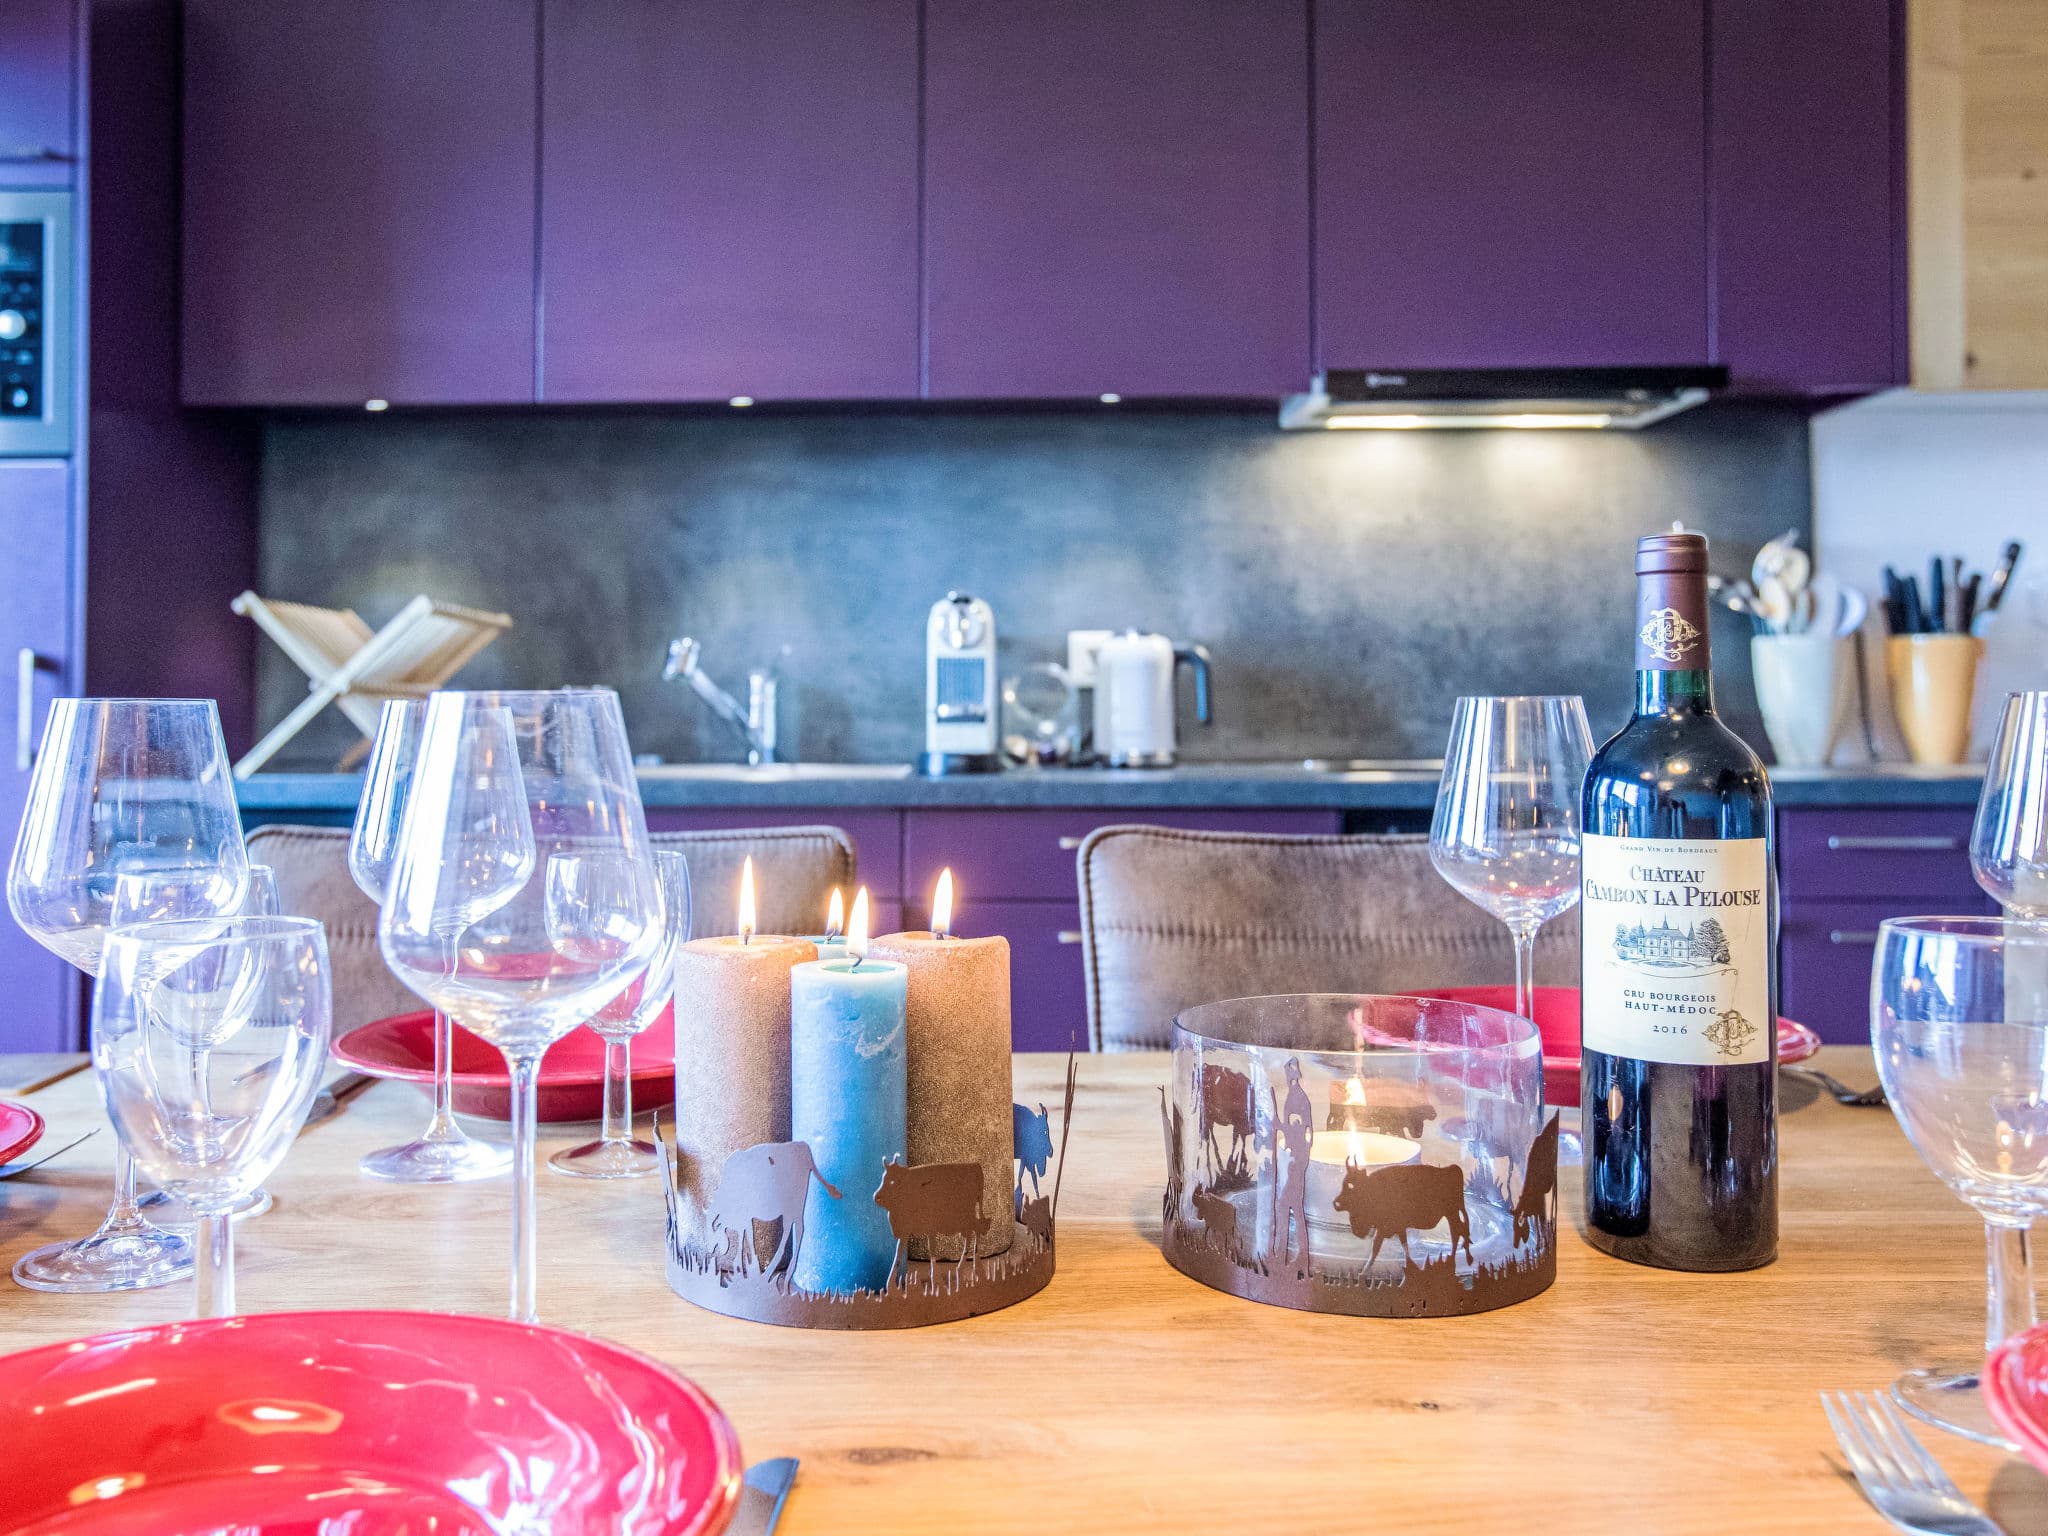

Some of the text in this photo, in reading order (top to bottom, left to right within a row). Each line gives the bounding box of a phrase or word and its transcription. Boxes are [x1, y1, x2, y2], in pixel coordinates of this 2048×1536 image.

[1620, 844, 1644, 852] GRAND
[1631, 864, 1705, 883] CHÂTEAU
[1586, 878, 1761, 907] CAMBON LA PELOUSE
[1623, 989, 1716, 1002] CRU BOURGEOIS
[1625, 1001, 1717, 1015] HAUT-MÉDOC
[1652, 1025, 1688, 1035] 2016
